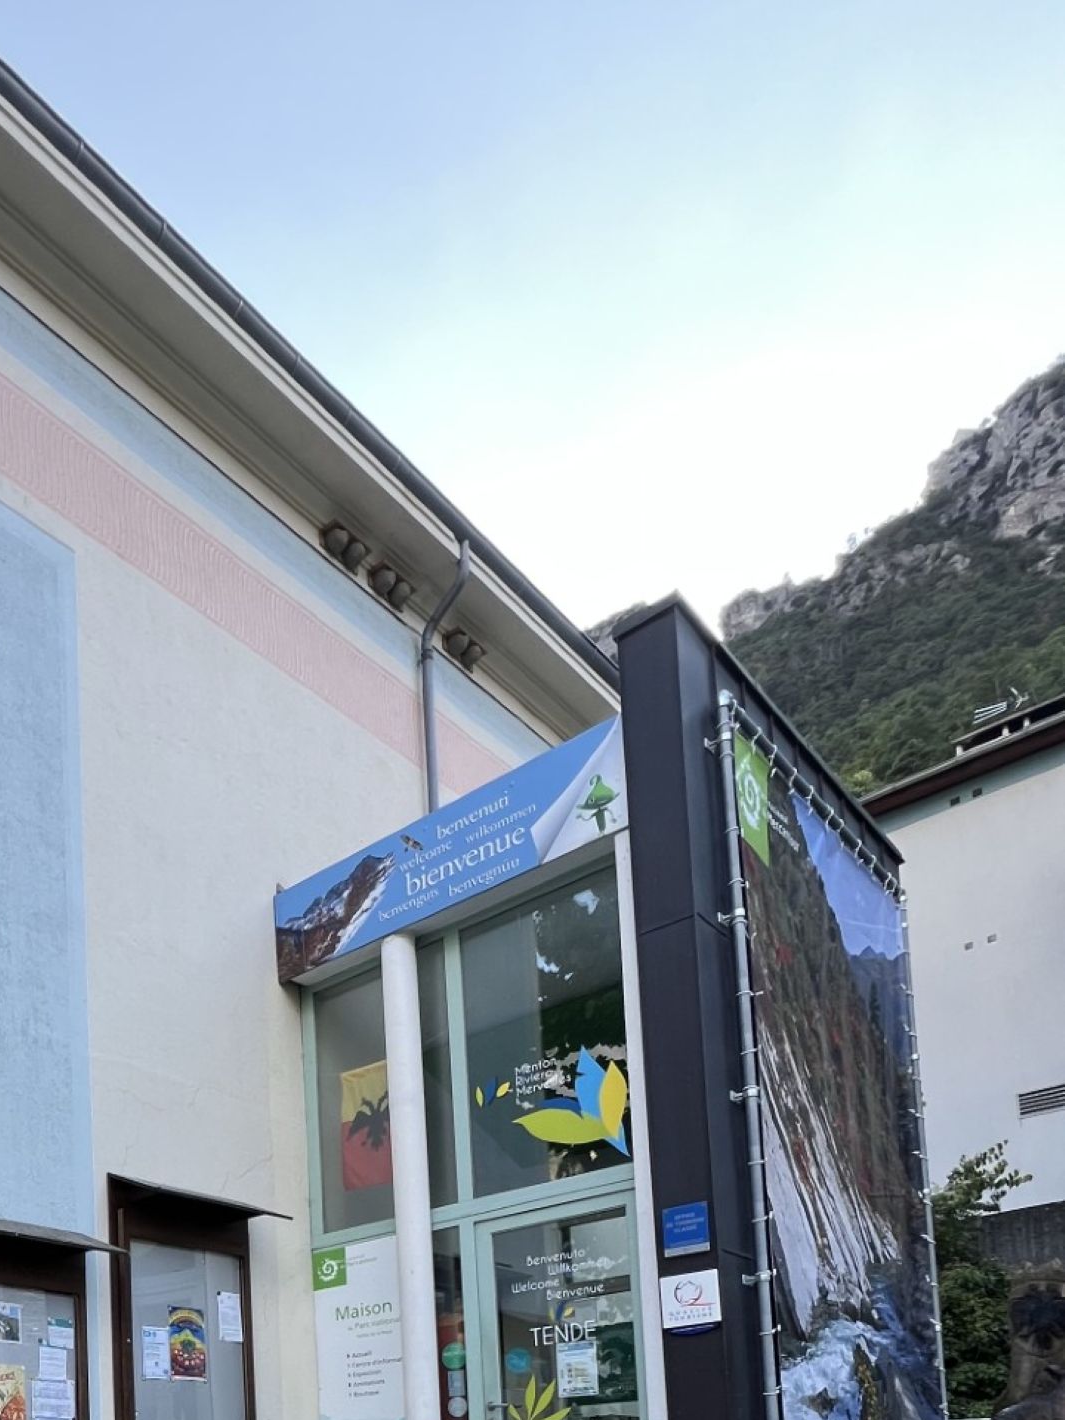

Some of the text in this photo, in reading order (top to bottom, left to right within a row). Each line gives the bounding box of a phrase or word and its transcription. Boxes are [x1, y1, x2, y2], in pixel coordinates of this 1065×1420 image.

[436, 790, 510, 841] benvenuti
[399, 838, 453, 873] welcome
[404, 826, 525, 896] bienvenue
[515, 1058, 557, 1073] Menton
[526, 1248, 586, 1267] Benvenuto
[511, 1278, 560, 1294] Welcome
[546, 1283, 605, 1301] Bienvenue
[335, 1302, 393, 1321] Maison
[529, 1319, 597, 1347] TENDE
